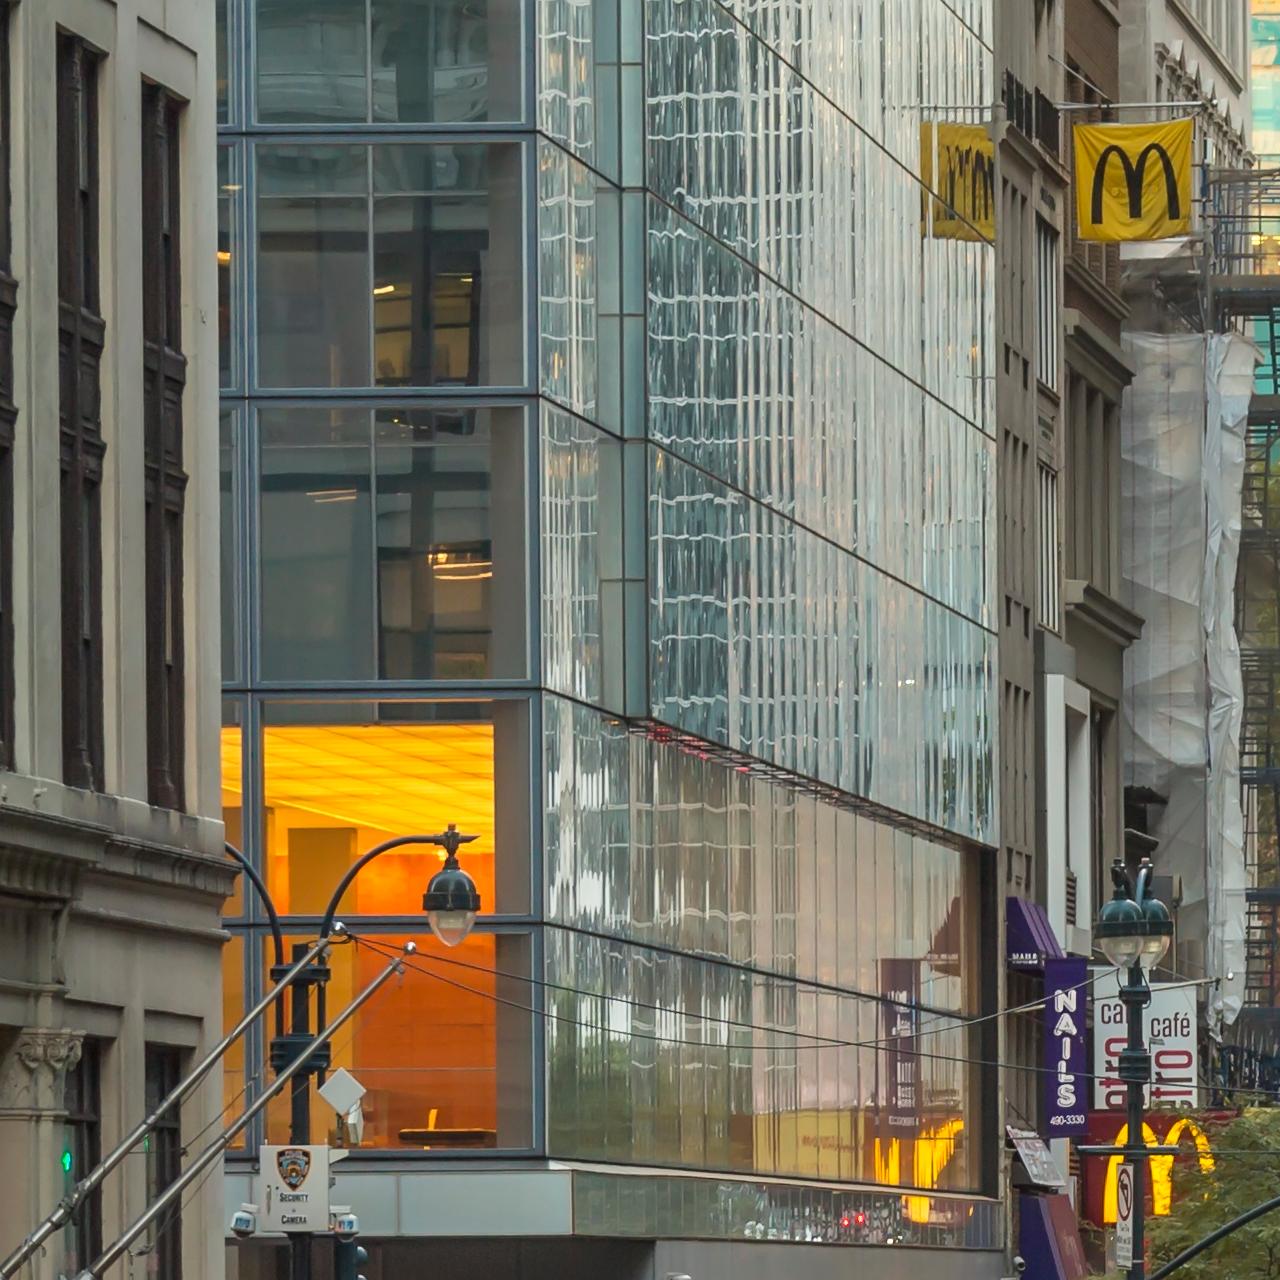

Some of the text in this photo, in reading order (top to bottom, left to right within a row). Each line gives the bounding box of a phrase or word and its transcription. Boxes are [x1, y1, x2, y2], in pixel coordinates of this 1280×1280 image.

[1101, 1003, 1128, 1025] ca
[1151, 1012, 1191, 1038] café
[1054, 989, 1077, 1108] NAILS
